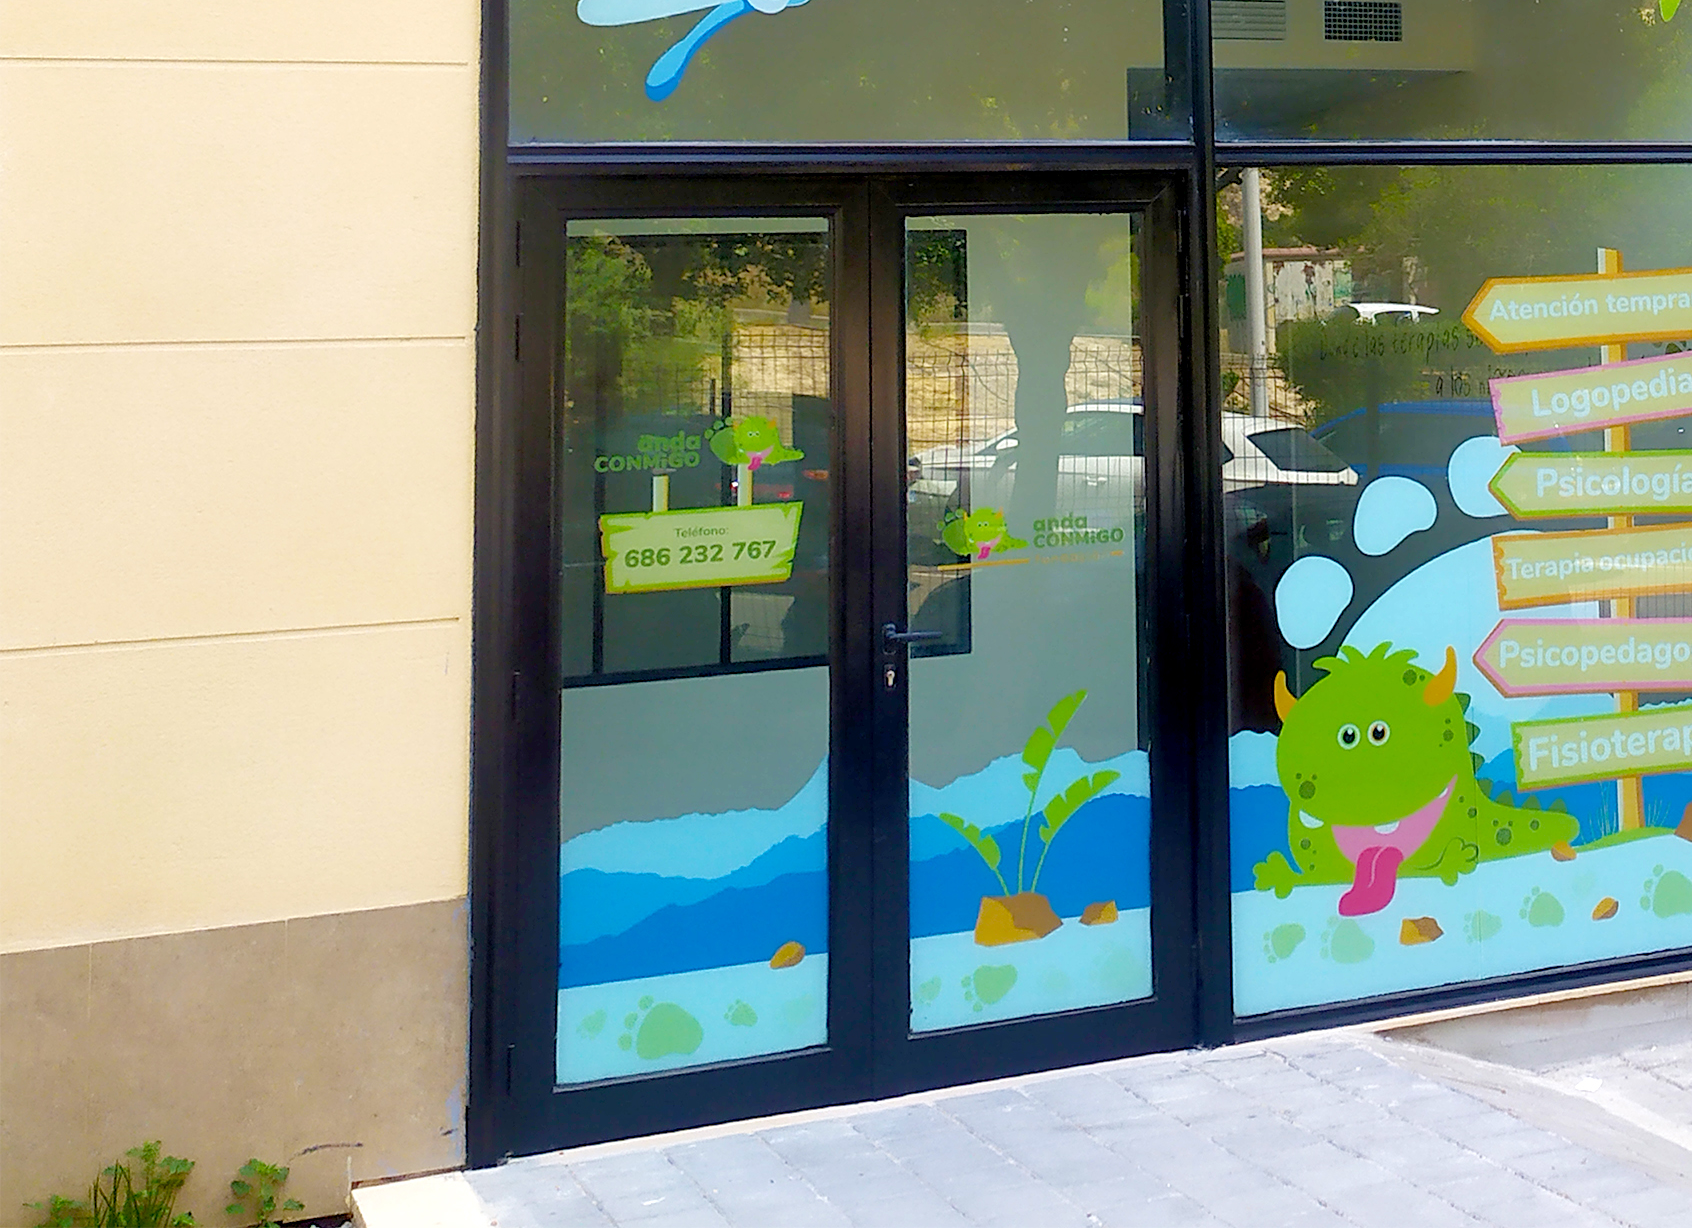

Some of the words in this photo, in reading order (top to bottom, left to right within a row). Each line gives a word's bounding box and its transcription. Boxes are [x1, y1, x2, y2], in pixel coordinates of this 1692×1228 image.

[1489, 292, 1598, 322] Atención
[637, 430, 700, 453] anda
[675, 526, 729, 538] Teléfono:
[1033, 512, 1088, 532] anda
[625, 548, 671, 568] 686
[679, 544, 723, 564] 232
[732, 540, 776, 560] 767
[1505, 551, 1594, 581] Terapia
